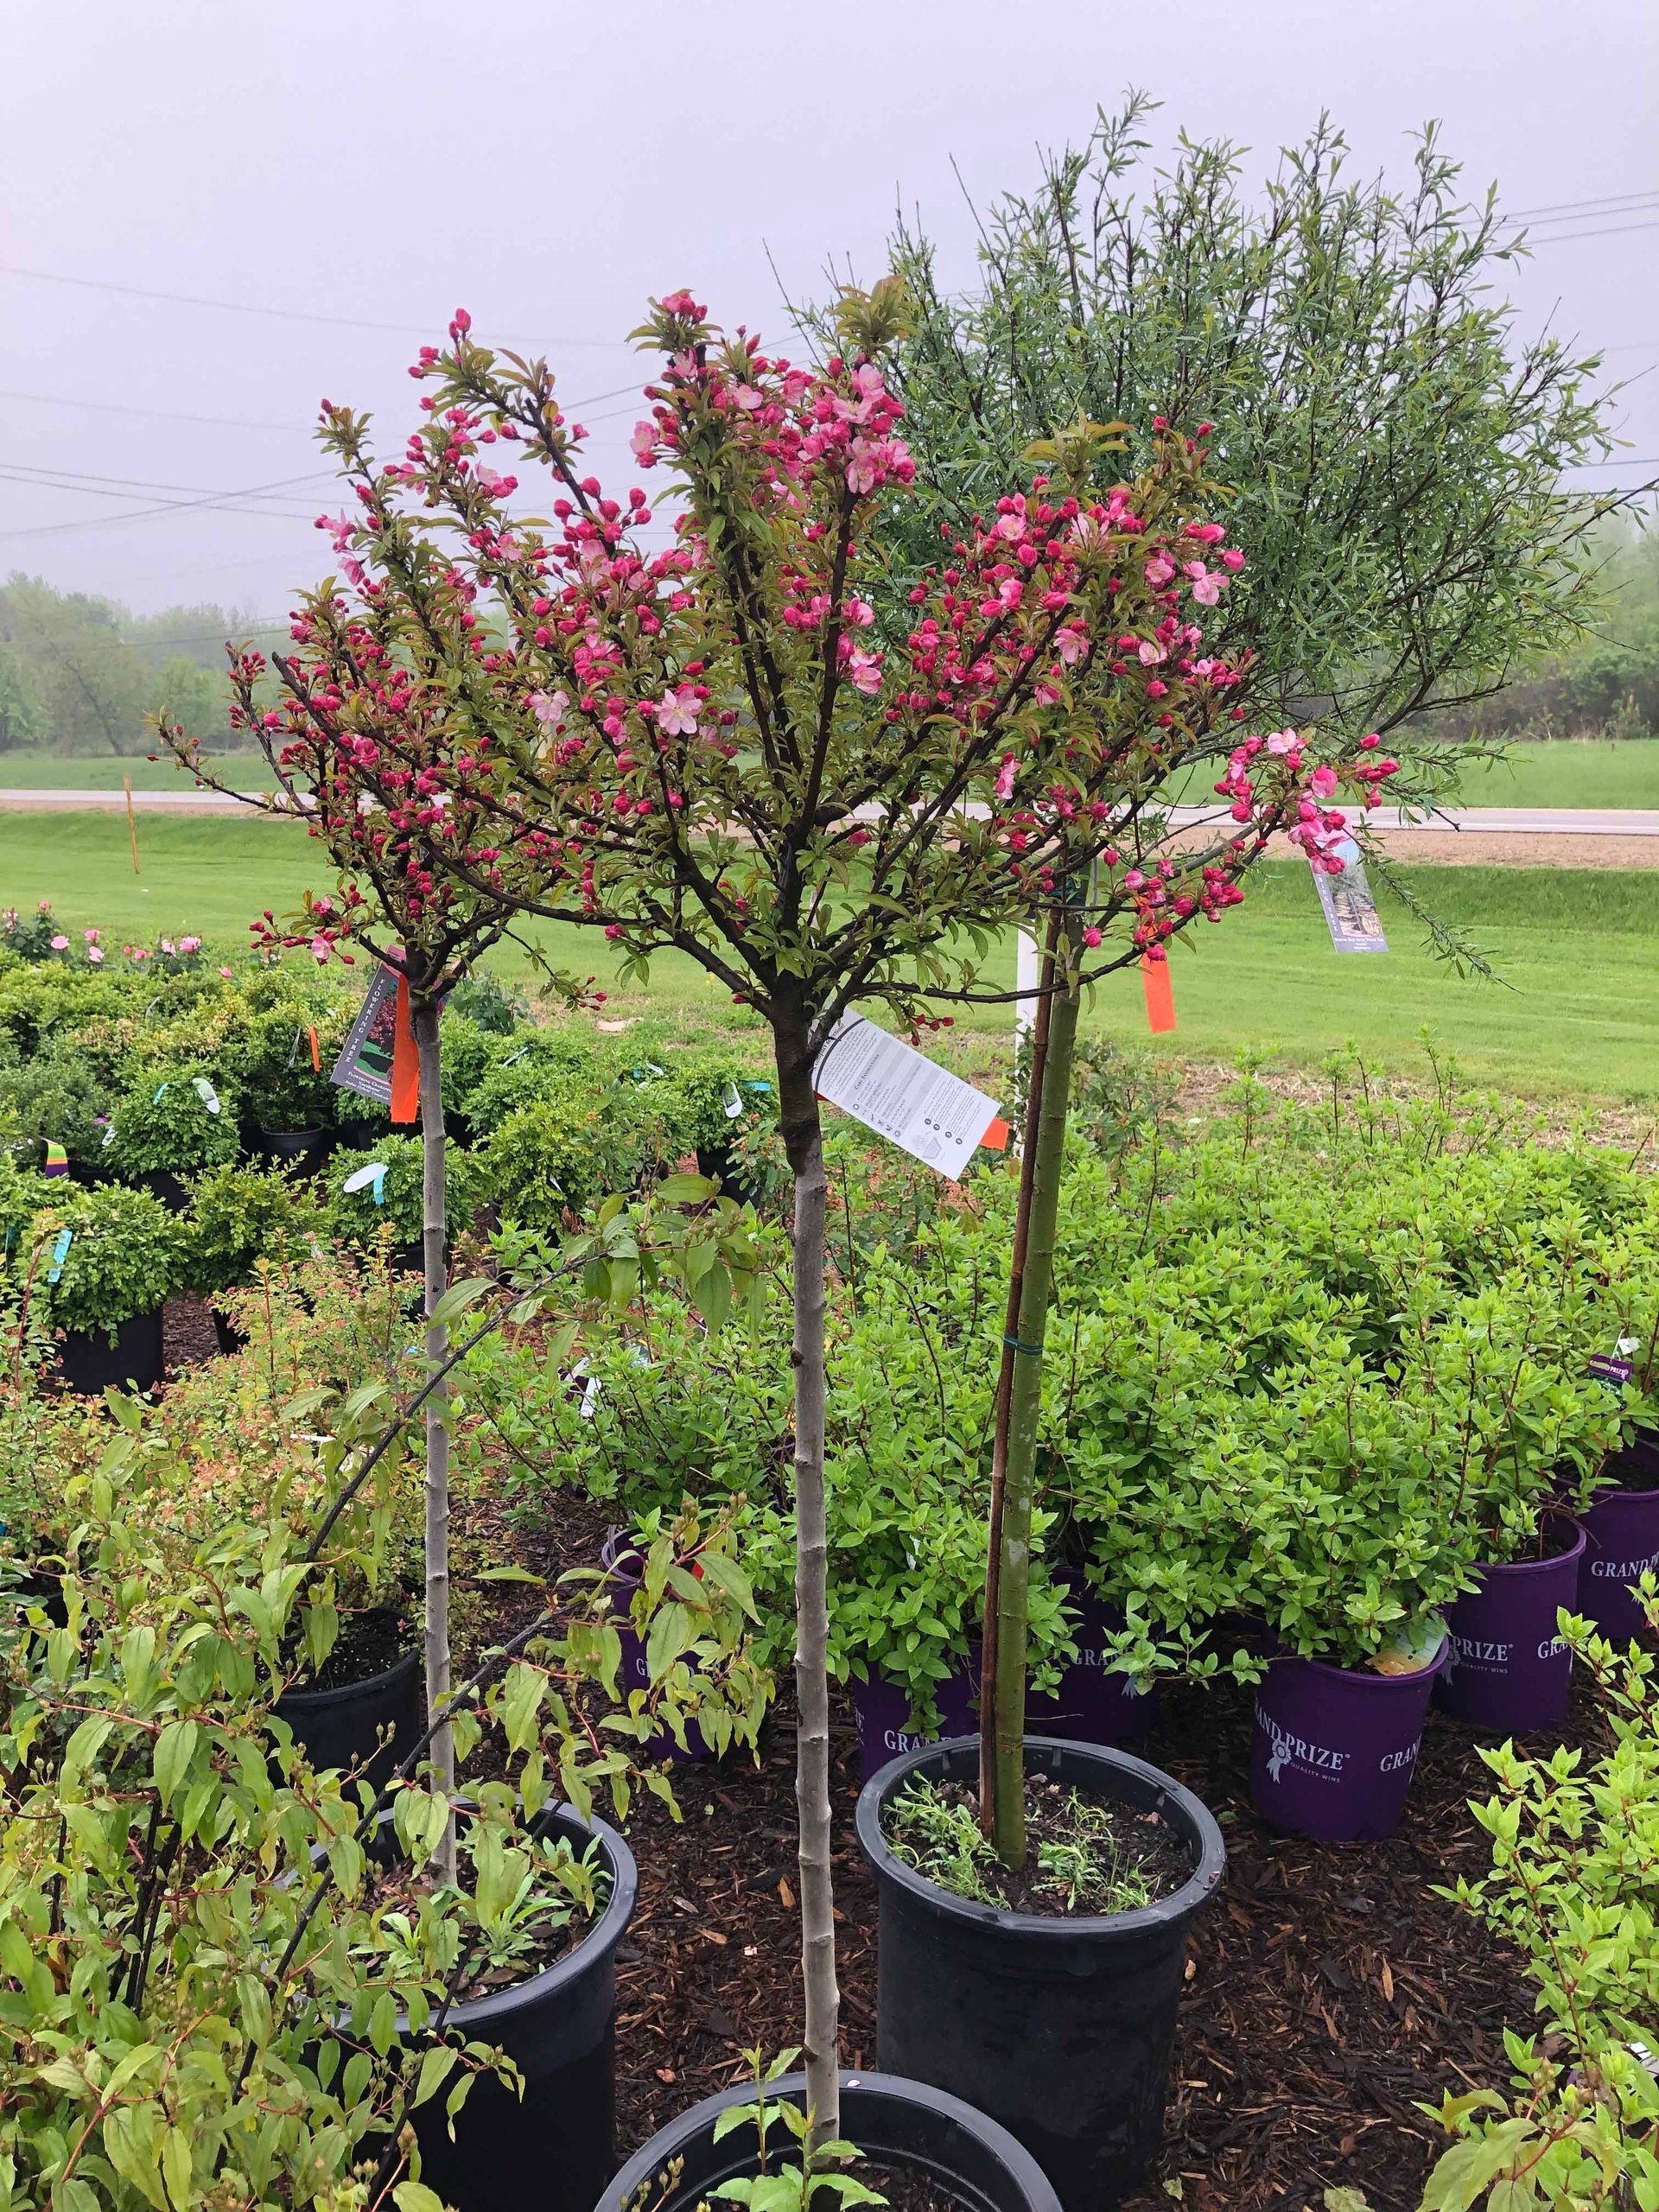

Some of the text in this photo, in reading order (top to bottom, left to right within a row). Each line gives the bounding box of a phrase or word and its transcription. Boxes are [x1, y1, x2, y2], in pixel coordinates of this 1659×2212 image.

[345, 978, 385, 1063] FLOWERING TREE
[1591, 1559, 1649, 1578] GRAND
[1537, 1641, 1568, 1659] GRA
[1380, 1735, 1421, 1772] GRAN
[1290, 1762, 1341, 1783] QUALITY WINS
